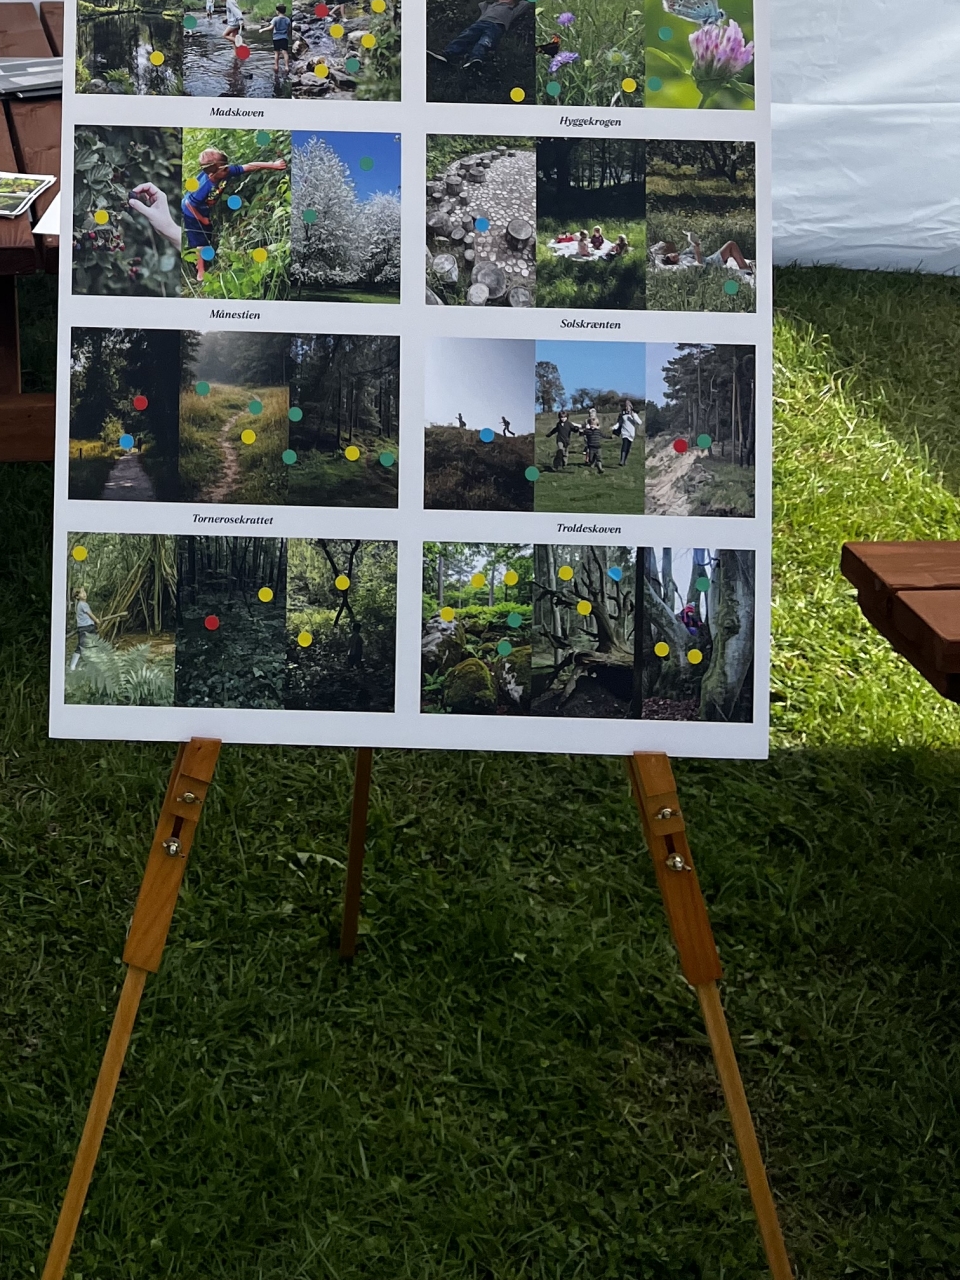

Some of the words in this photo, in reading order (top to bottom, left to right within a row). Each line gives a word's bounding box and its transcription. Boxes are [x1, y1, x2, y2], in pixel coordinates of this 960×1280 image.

[209, 106, 264, 118] Madskoven
[559, 115, 622, 129] Hyggekrogen
[209, 308, 261, 320] Månestien
[559, 318, 621, 330] Solskrænten
[192, 513, 274, 525] Tornerosekrattet
[556, 522, 622, 534] Troldeskoven
